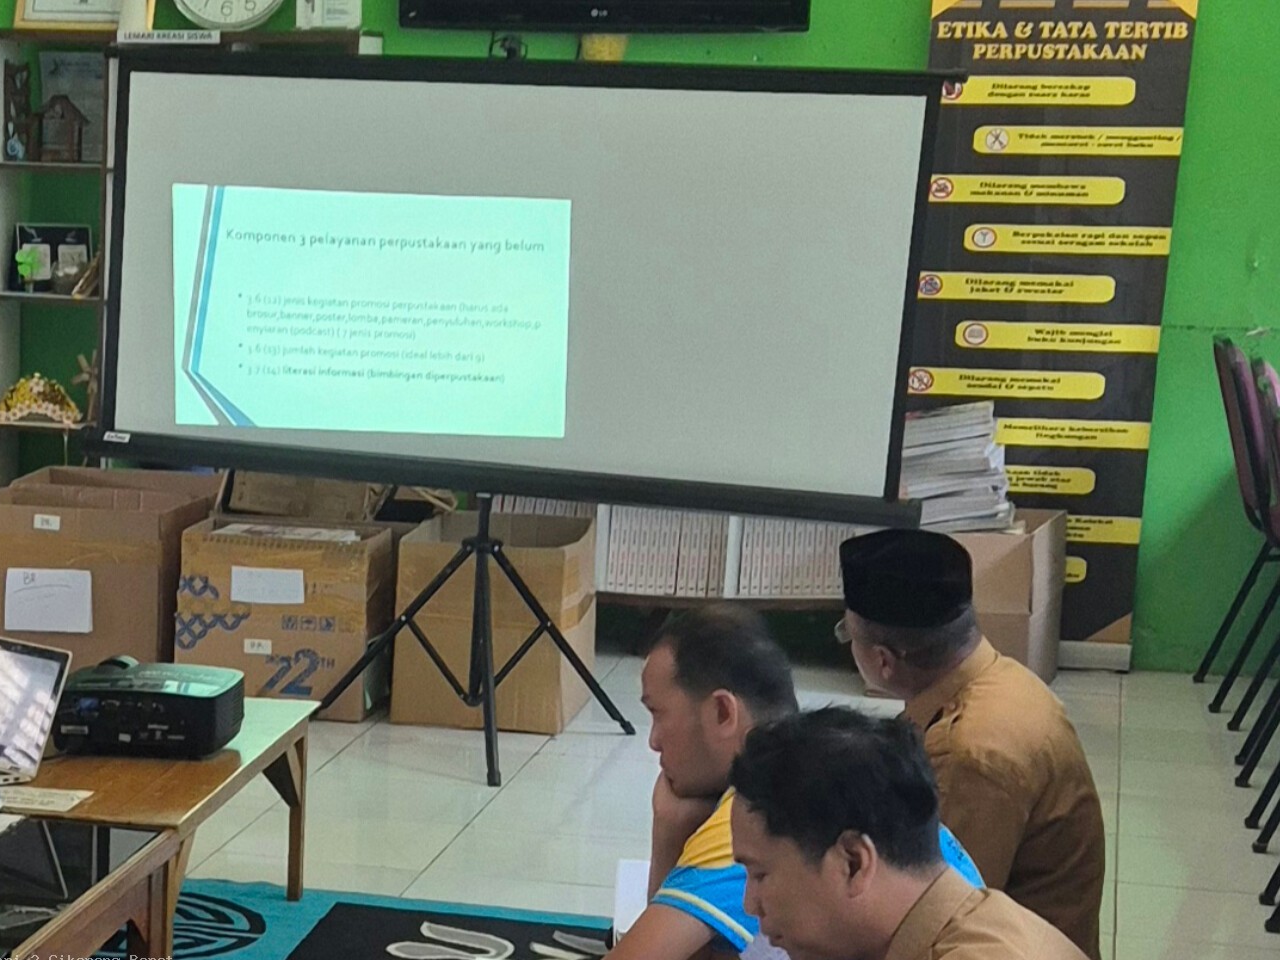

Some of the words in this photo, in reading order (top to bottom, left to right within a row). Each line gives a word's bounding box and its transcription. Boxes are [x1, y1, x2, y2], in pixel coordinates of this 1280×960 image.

[220, 0, 233, 17] 6
[123, 31, 154, 41] LEMARI
[156, 31, 184, 41] KREASI
[187, 31, 212, 40] SISWA
[937, 21, 1008, 39] ETIKA
[1014, 21, 1034, 39] &
[1038, 21, 1098, 39] TATA
[1104, 21, 1188, 39] TERTIB
[973, 43, 1148, 60] PERPUSTAKAAN
[991, 82, 1037, 91] Dilarang
[979, 181, 1028, 190] Dilarang
[226, 228, 296, 245] Komponen
[300, 233, 306, 247] 3
[309, 231, 376, 249] pelayanan
[379, 235, 466, 252] perpustakaan
[470, 240, 501, 255] yang
[505, 238, 544, 252] belum
[965, 277, 1017, 287] Dilarang
[351, 299, 390, 311] promosi
[392, 300, 457, 312] perpustakaan
[360, 348, 399, 360] promosi
[318, 366, 365, 378] informasi
[958, 374, 1007, 383] Dilarang
